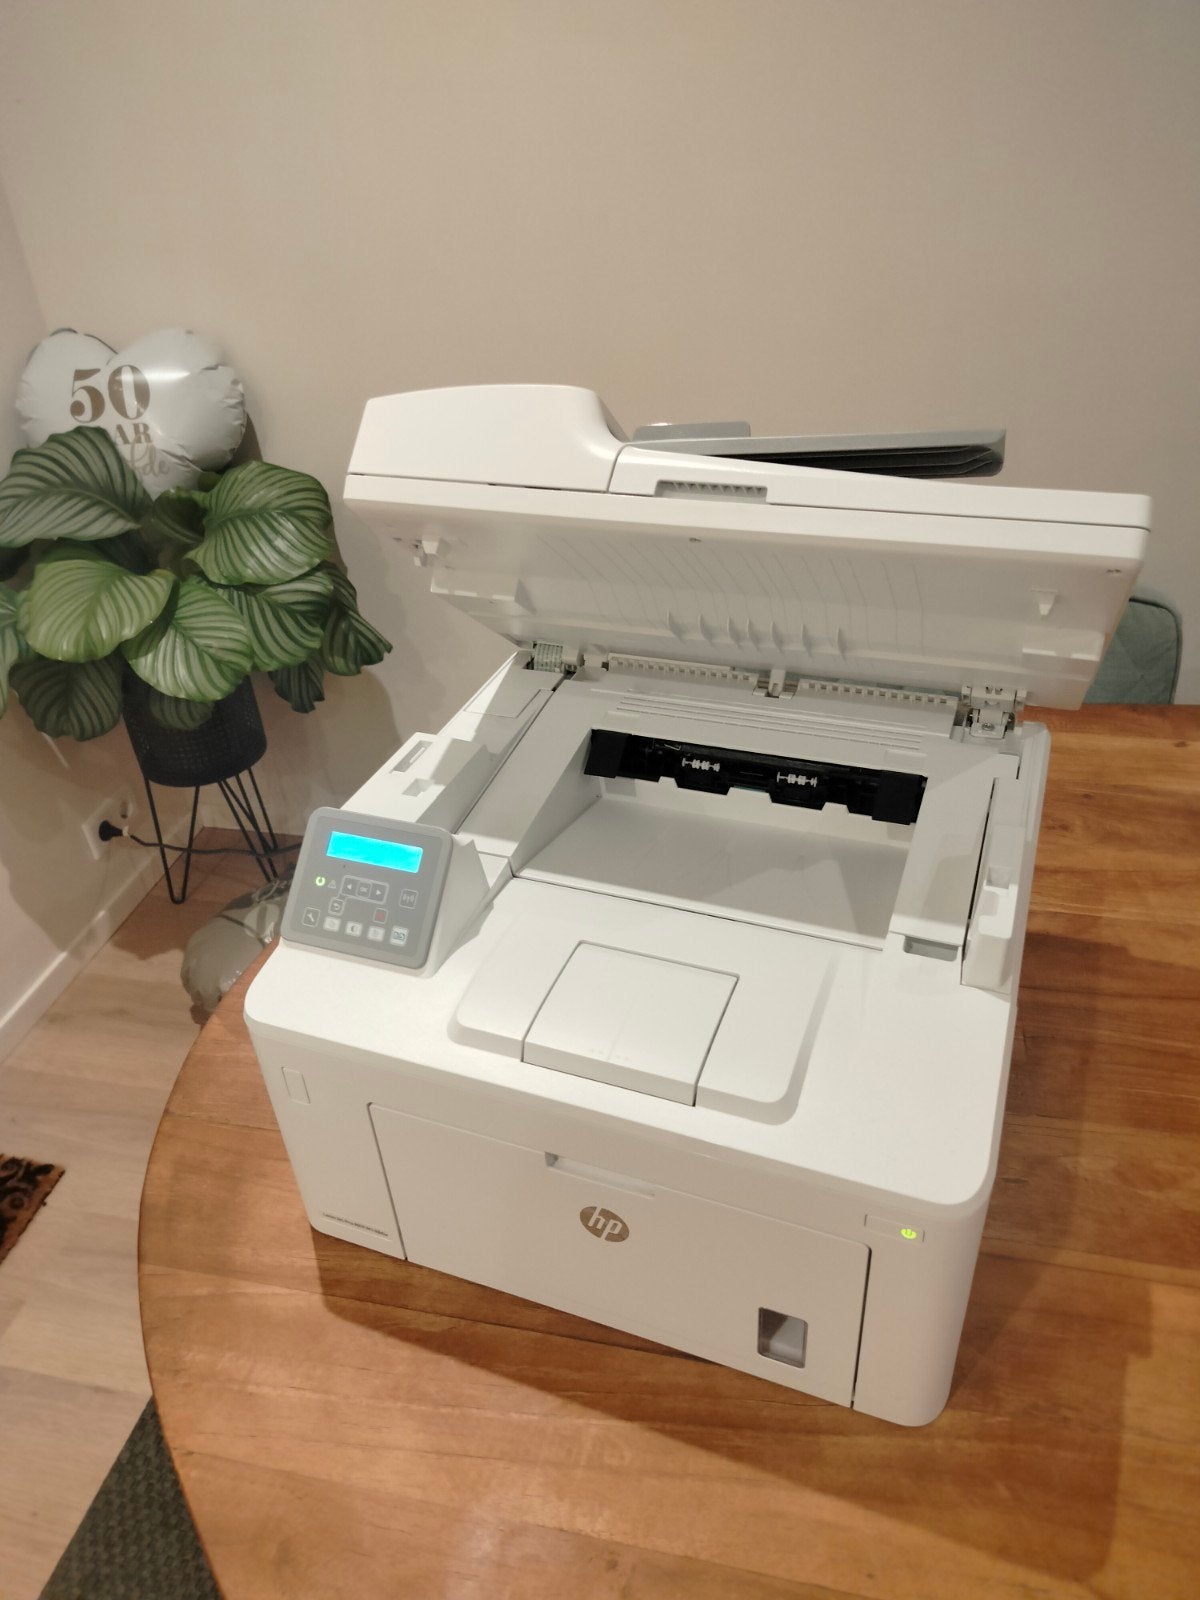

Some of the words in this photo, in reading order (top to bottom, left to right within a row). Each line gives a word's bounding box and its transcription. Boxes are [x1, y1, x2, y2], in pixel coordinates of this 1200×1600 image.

[70, 365, 151, 423] 50
[115, 423, 153, 445] AR
[584, 1206, 625, 1241] hp
